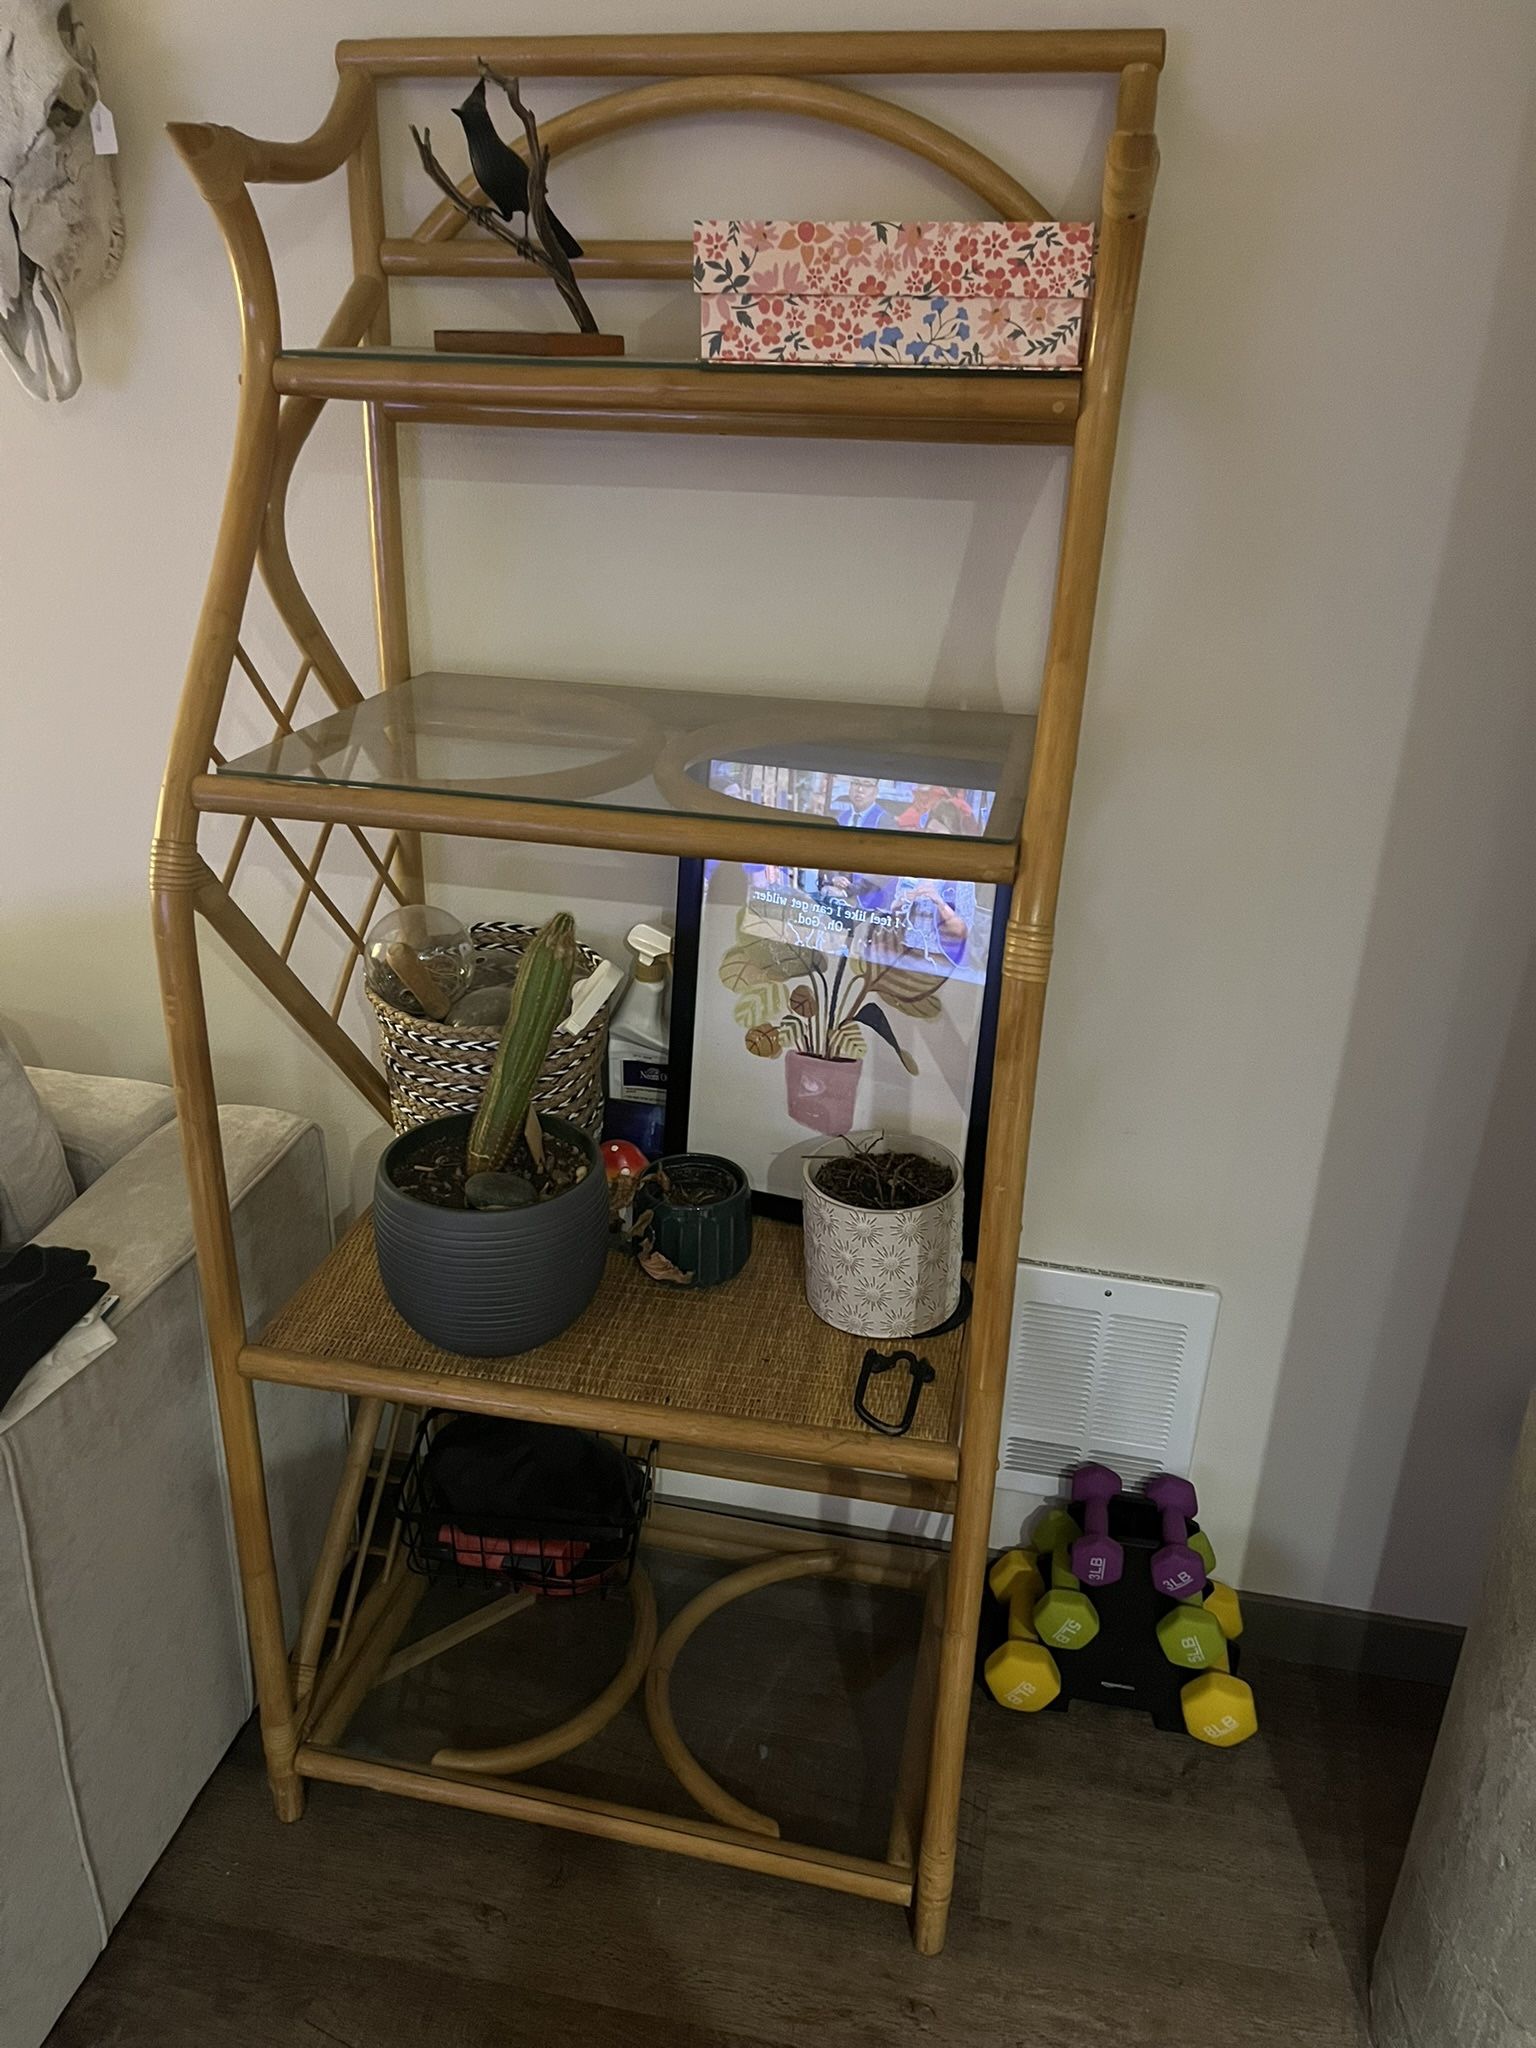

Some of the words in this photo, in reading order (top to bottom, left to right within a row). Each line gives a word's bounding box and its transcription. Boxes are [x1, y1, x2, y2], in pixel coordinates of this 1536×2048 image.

[1088, 1557, 1106, 1580] 3LB
[1162, 1571, 1194, 1591] 3LB
[1052, 1618, 1082, 1644] 5LB
[1181, 1635, 1205, 1664] 5LB
